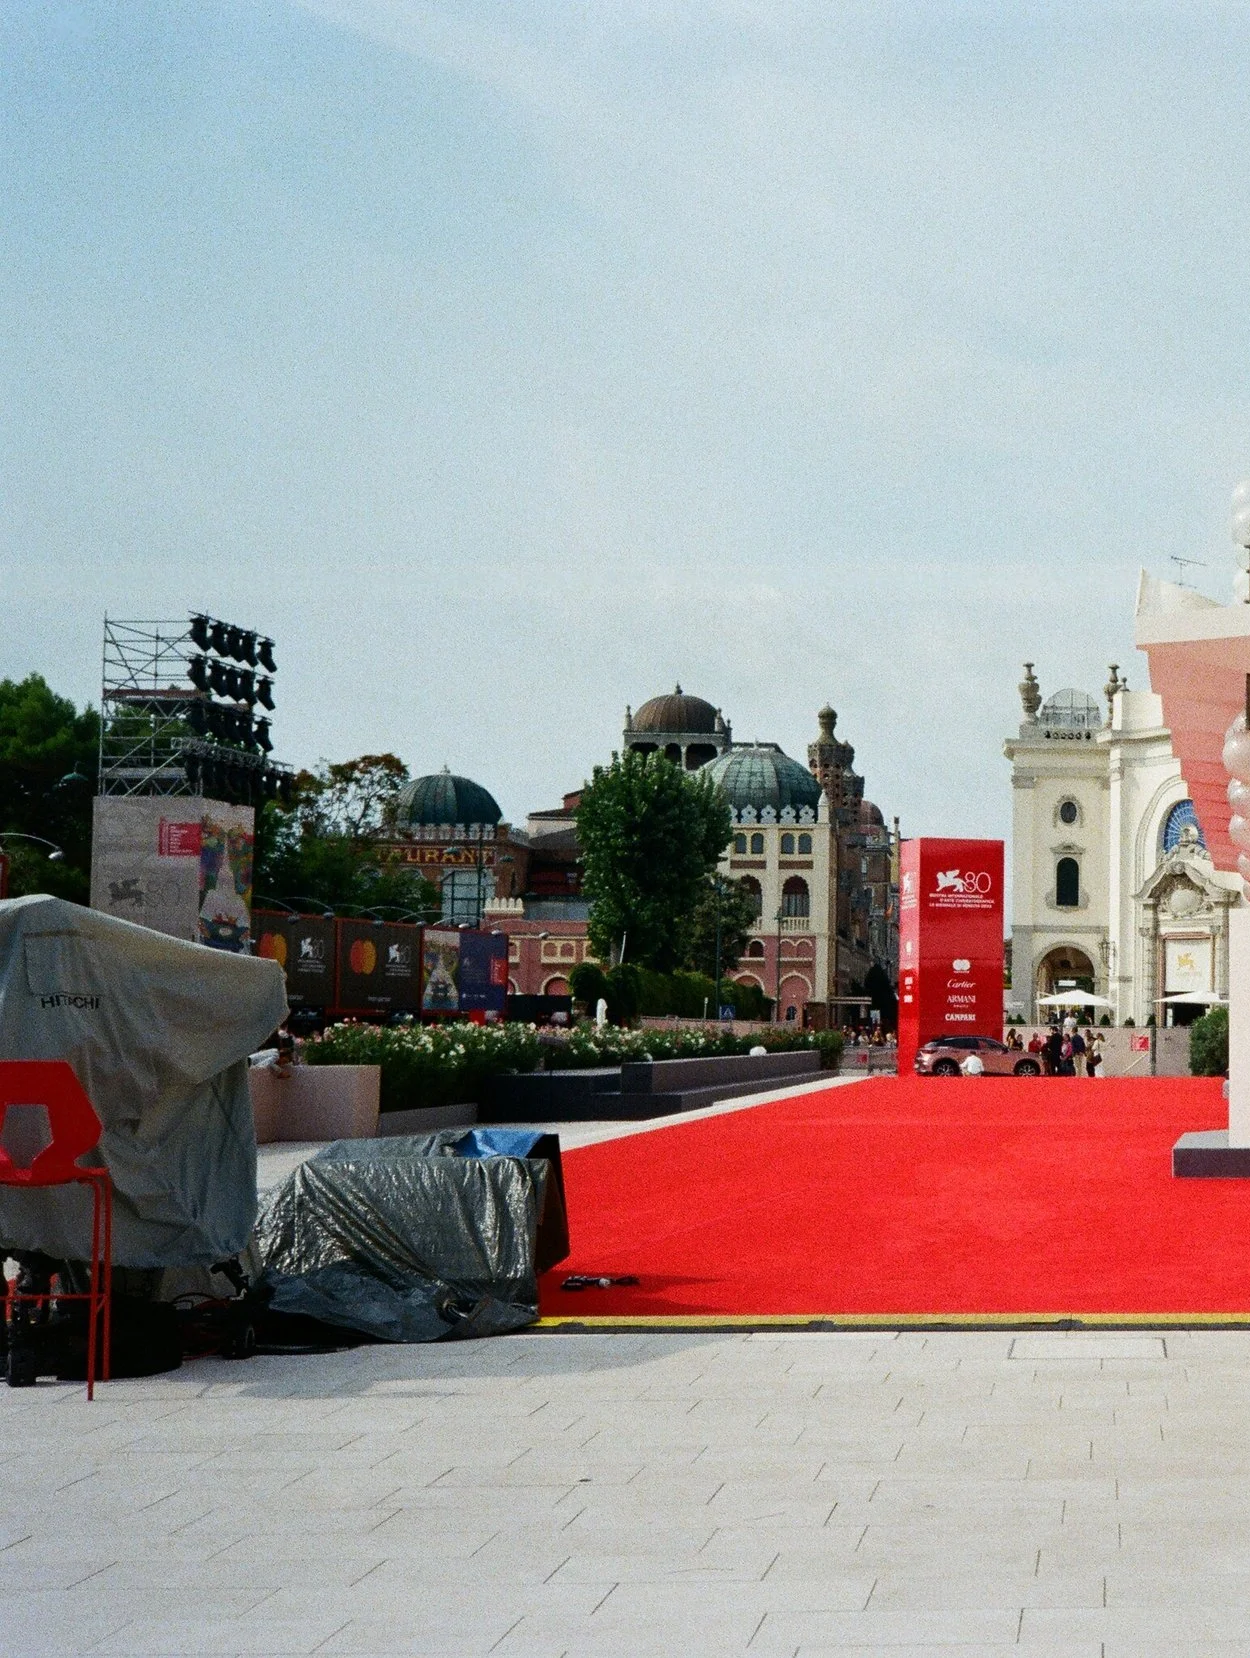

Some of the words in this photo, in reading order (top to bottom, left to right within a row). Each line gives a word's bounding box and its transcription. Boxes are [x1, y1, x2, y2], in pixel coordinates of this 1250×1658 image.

[965, 871, 991, 893] 80
[947, 979, 976, 988] Cartier
[947, 995, 976, 1003] ARMANI
[945, 1013, 976, 1021] CAMPARI
